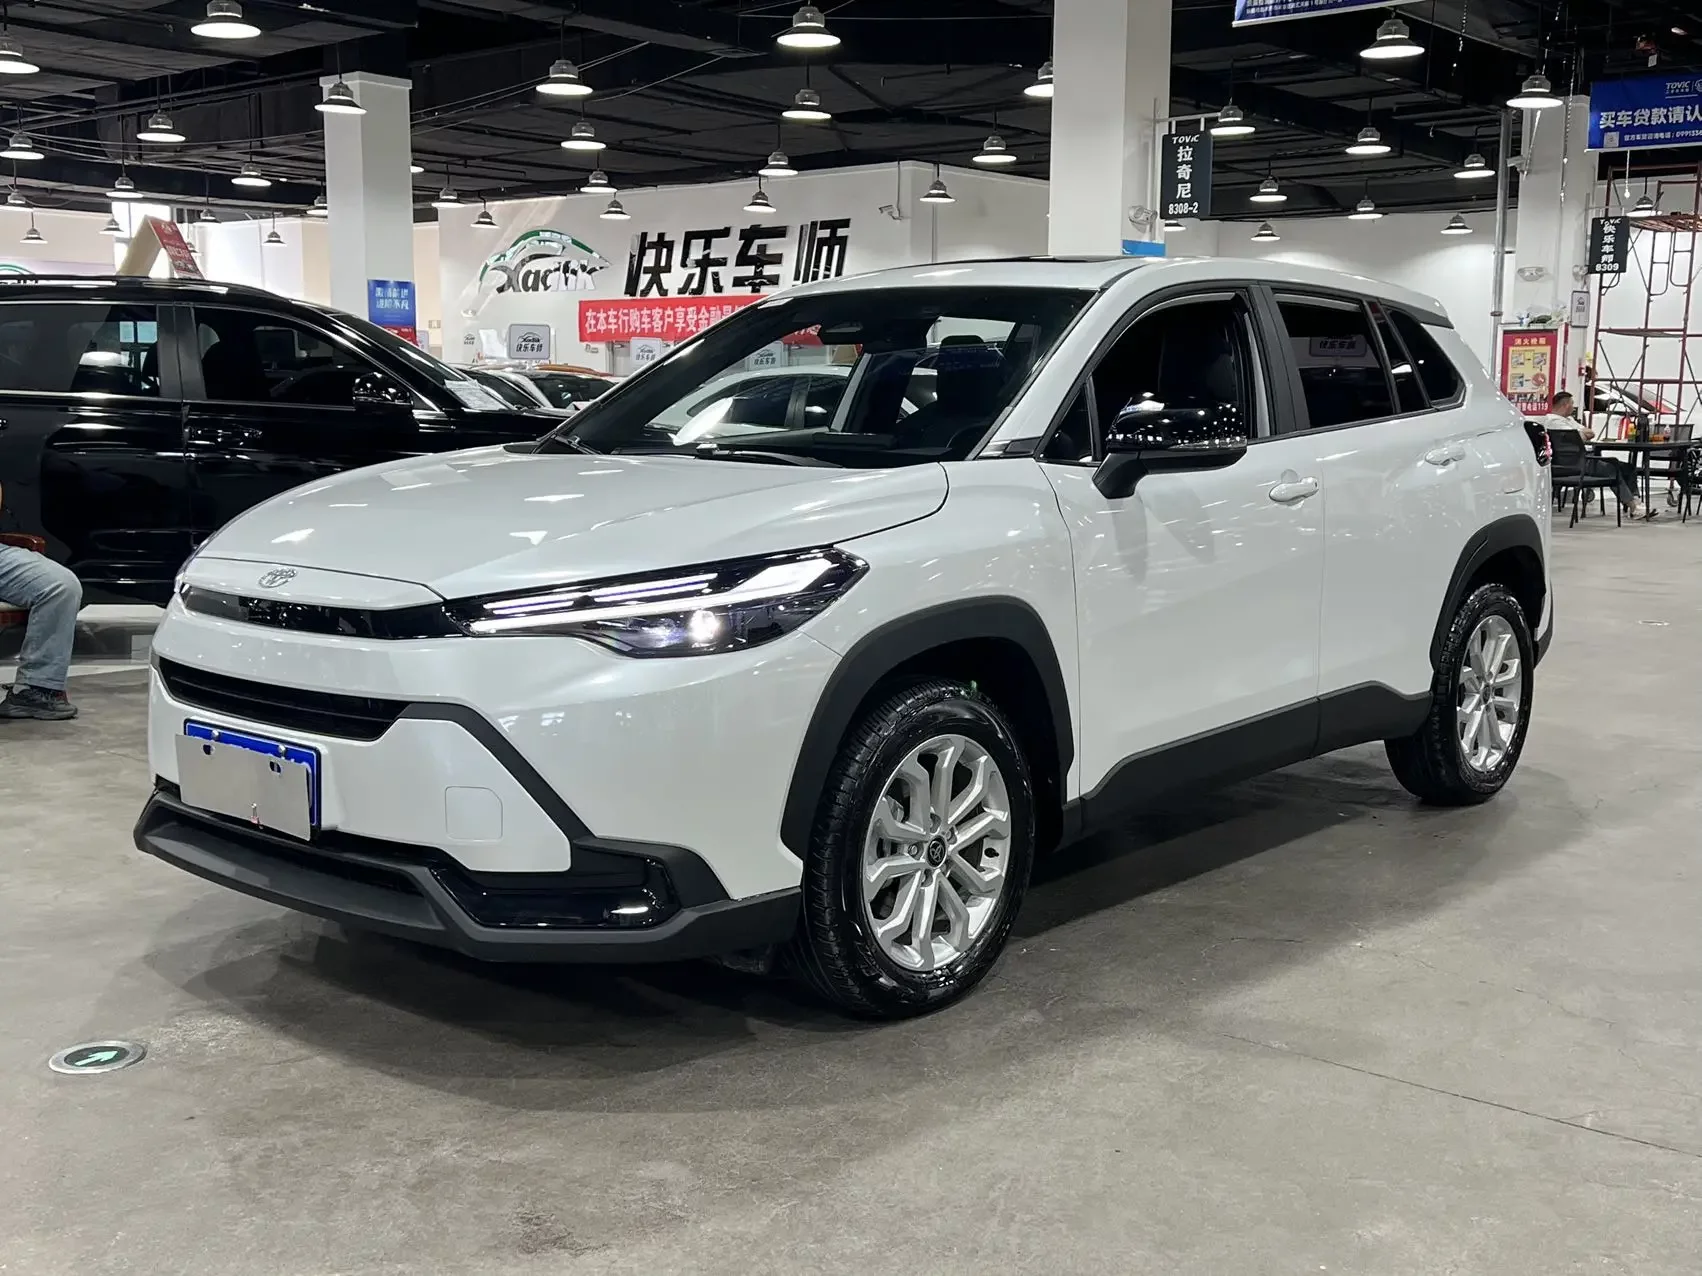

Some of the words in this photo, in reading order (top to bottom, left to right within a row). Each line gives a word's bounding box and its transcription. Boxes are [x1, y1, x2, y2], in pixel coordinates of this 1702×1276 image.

[1600, 104, 1702, 129] 买车贷款请认
[1171, 134, 1200, 144] TOVIC
[1176, 145, 1193, 199] 拉奇尼
[1168, 202, 1199, 215] 8308-2
[624, 217, 851, 297] 快乐车师
[585, 304, 746, 334] 在本车行购车客户享受金融
